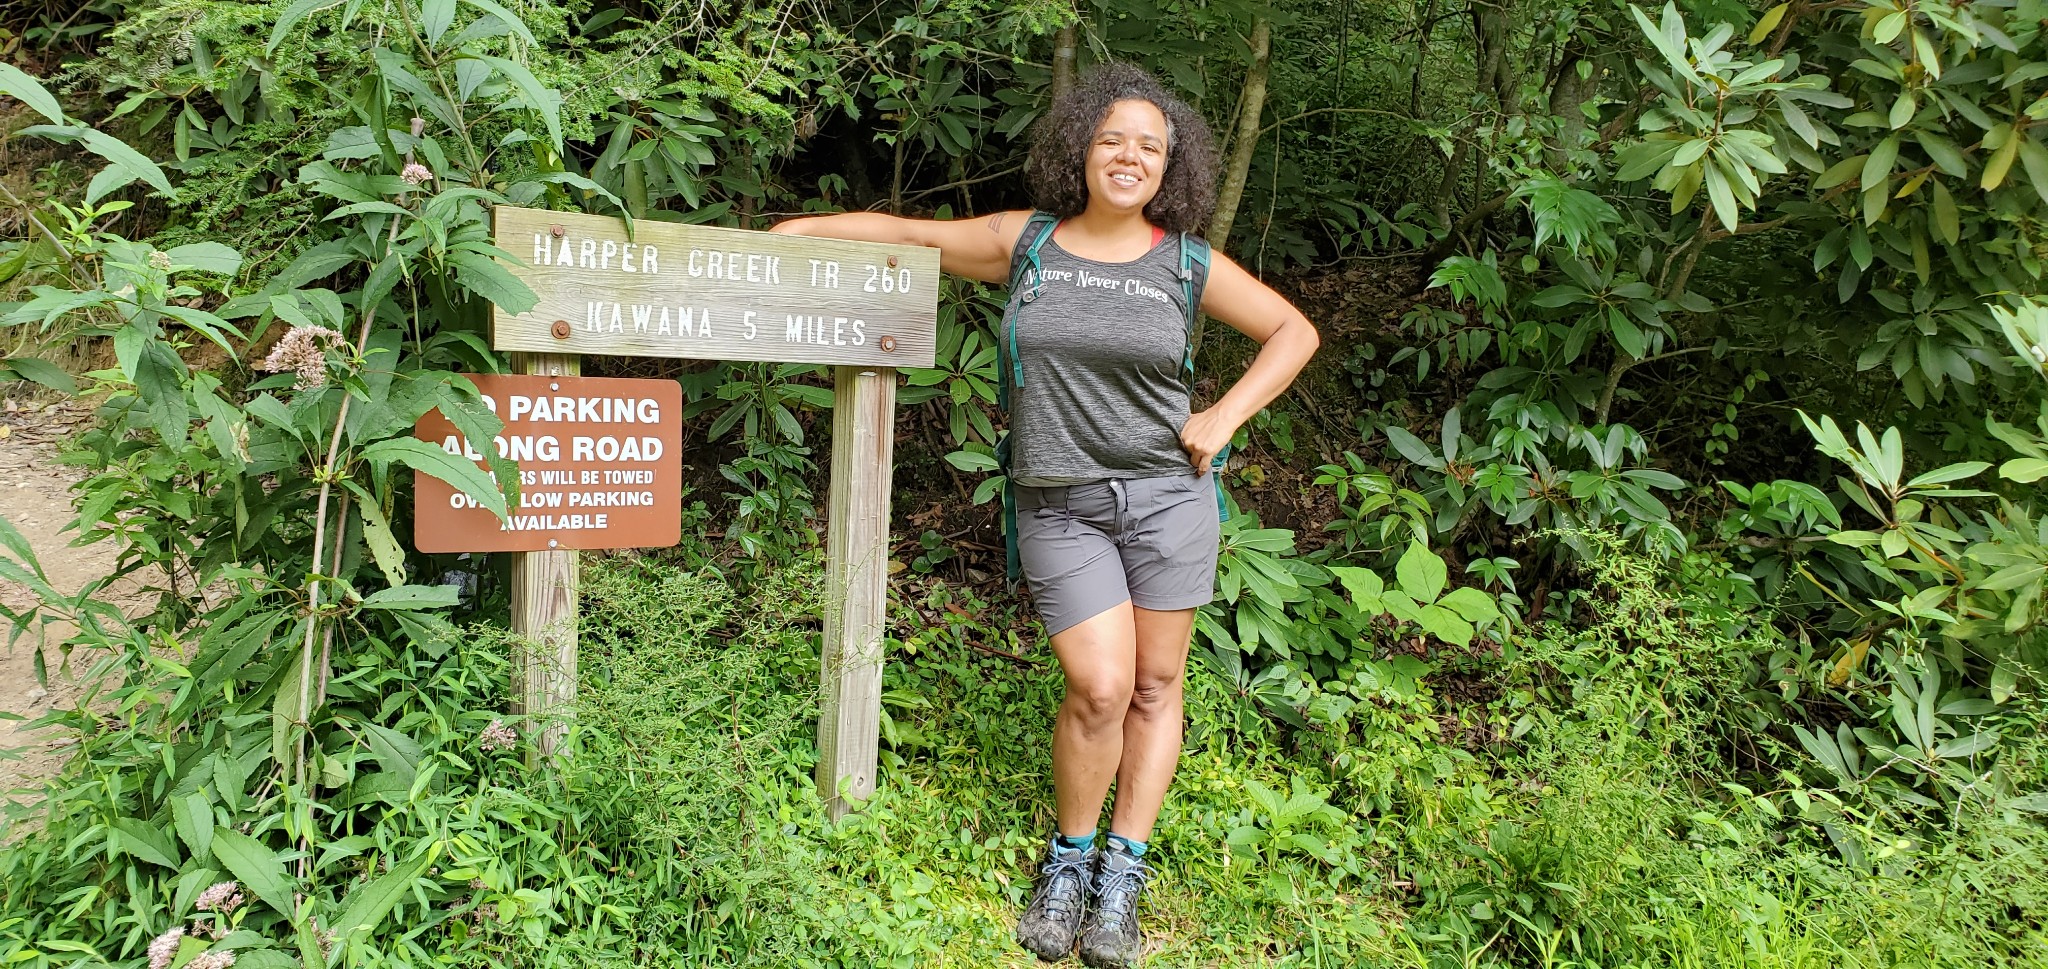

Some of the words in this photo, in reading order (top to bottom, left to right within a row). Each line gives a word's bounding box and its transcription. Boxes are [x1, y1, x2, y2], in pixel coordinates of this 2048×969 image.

[533, 233, 659, 274] HARPER
[687, 247, 781, 285] CREEK
[808, 258, 840, 289] TR
[863, 264, 911, 294] 260
[1076, 270, 1120, 290] Never
[1124, 279, 1168, 303] Closes
[586, 301, 713, 338] KAWANA
[743, 310, 758, 340] 5
[785, 314, 867, 346] MILES
[509, 395, 661, 424] PARKING
[572, 436, 663, 462] ROAD
[541, 470, 577, 485] WILL
[581, 470, 600, 485] BE
[603, 469, 653, 485] TOWED
[569, 491, 654, 507] PARKING
[500, 513, 608, 531] AVAILABLE
